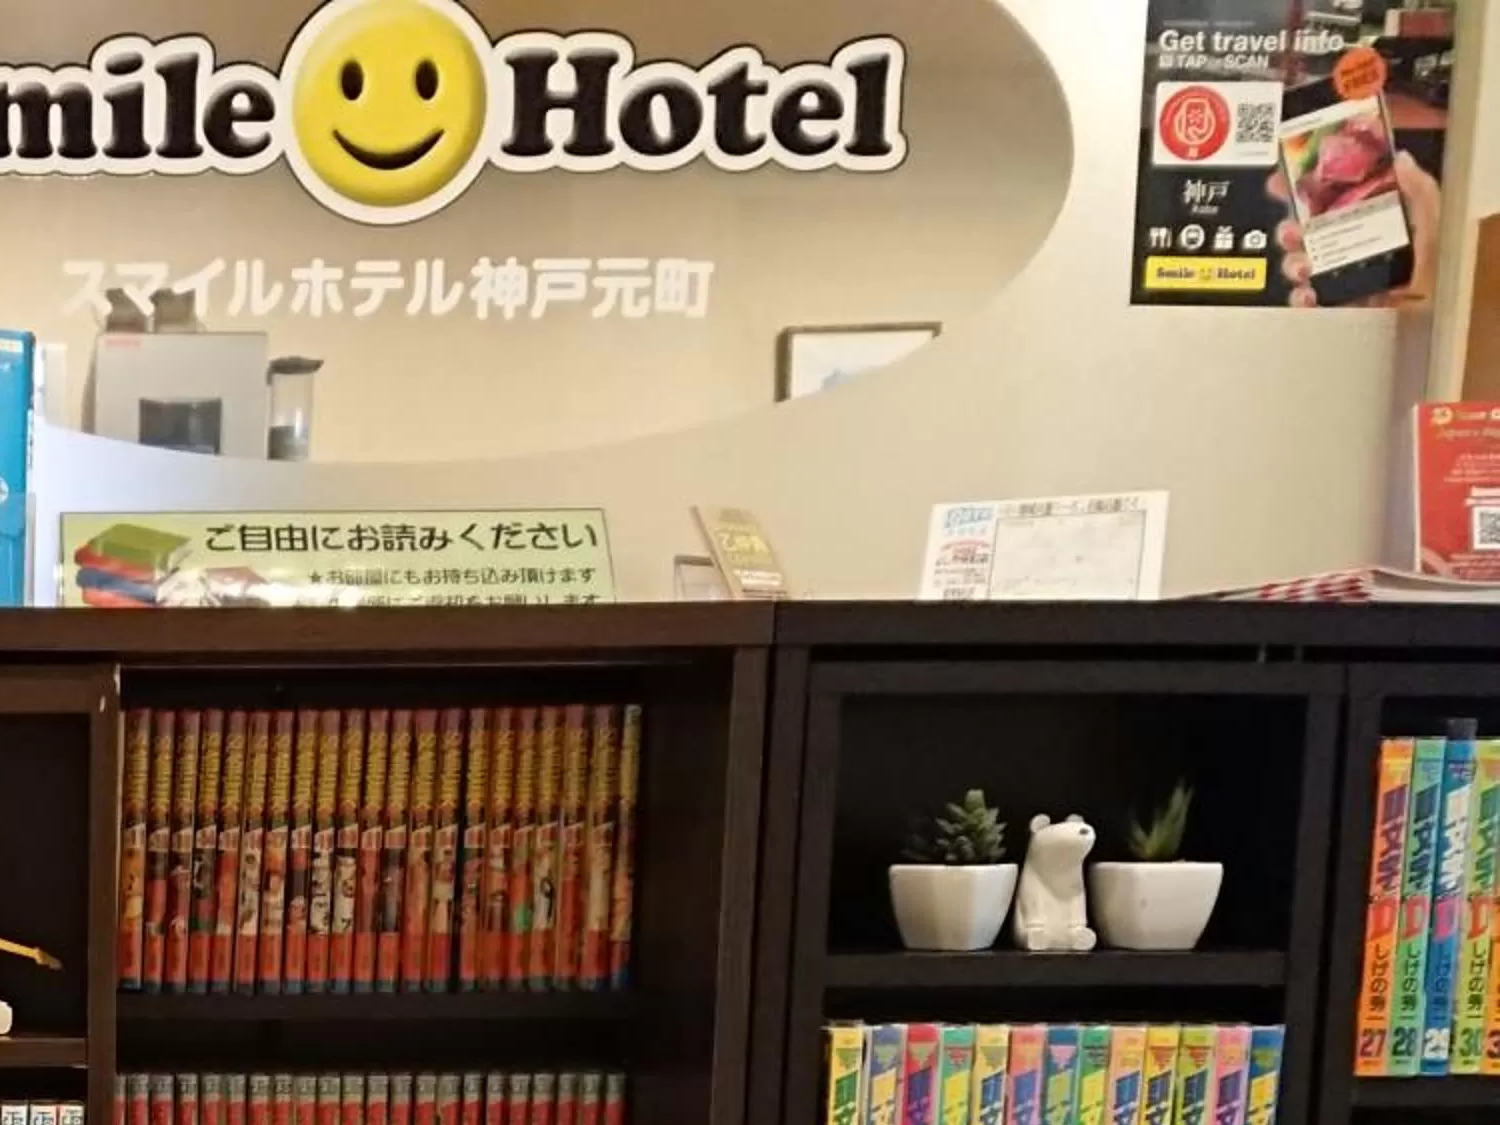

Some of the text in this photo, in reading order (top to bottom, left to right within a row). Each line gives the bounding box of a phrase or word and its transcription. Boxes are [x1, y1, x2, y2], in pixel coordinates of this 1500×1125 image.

[1158, 29, 1344, 52] Get travel info
[1177, 54, 1206, 68] TAP
[1223, 54, 1270, 68] SCAN
[501, 46, 895, 159] Hotel
[1184, 180, 1232, 205] 神戸
[1156, 266, 1256, 280] Smile Hotel
[60, 257, 715, 319] スマイルホテル神戸元町
[205, 523, 598, 551] ご自由にお読みください
[1360, 1027, 1386, 1059] 27
